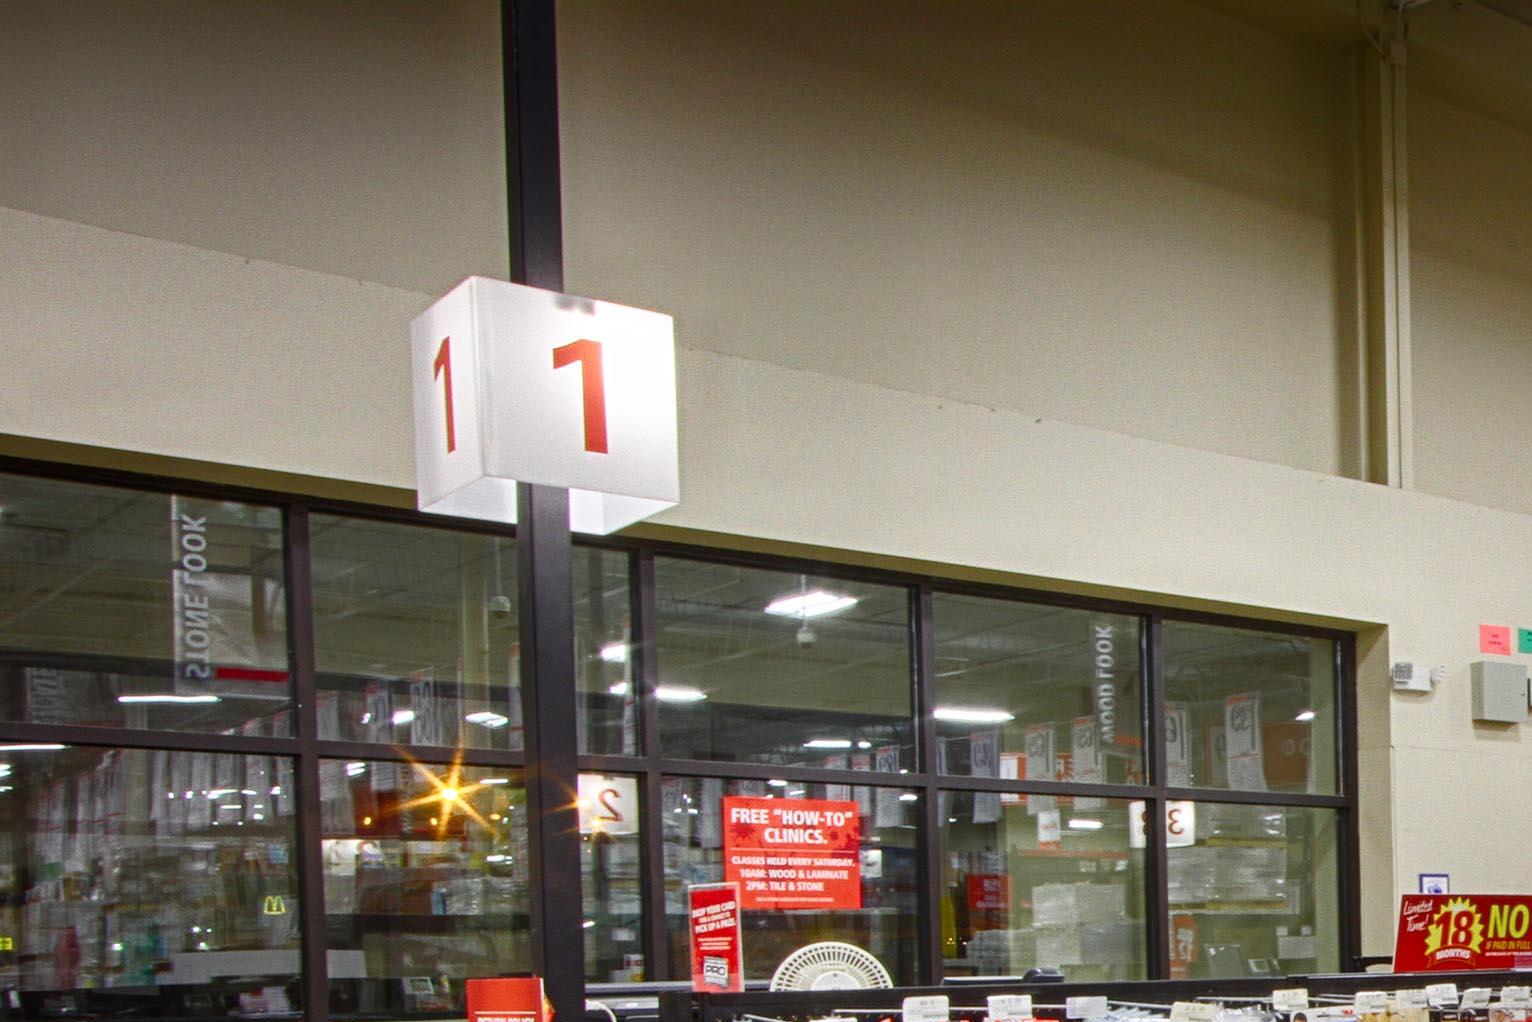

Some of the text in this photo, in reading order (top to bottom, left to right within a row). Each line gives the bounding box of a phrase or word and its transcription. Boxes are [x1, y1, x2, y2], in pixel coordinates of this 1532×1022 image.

[433, 336, 456, 454] 1
[552, 337, 608, 454] 1
[730, 808, 853, 826] FREE "HOW-TO"
[764, 828, 828, 844] CLINICS.
[732, 856, 855, 867] CLASSES HELD EVERY SATURDAY.
[769, 869, 796, 879] WOOD
[807, 870, 849, 880] LAMINATE
[769, 882, 786, 891] TILE
[797, 882, 824, 891] STONE
[1435, 911, 1475, 946] 18
[1487, 904, 1530, 939] NO
[1435, 948, 1471, 960] MONTHS
